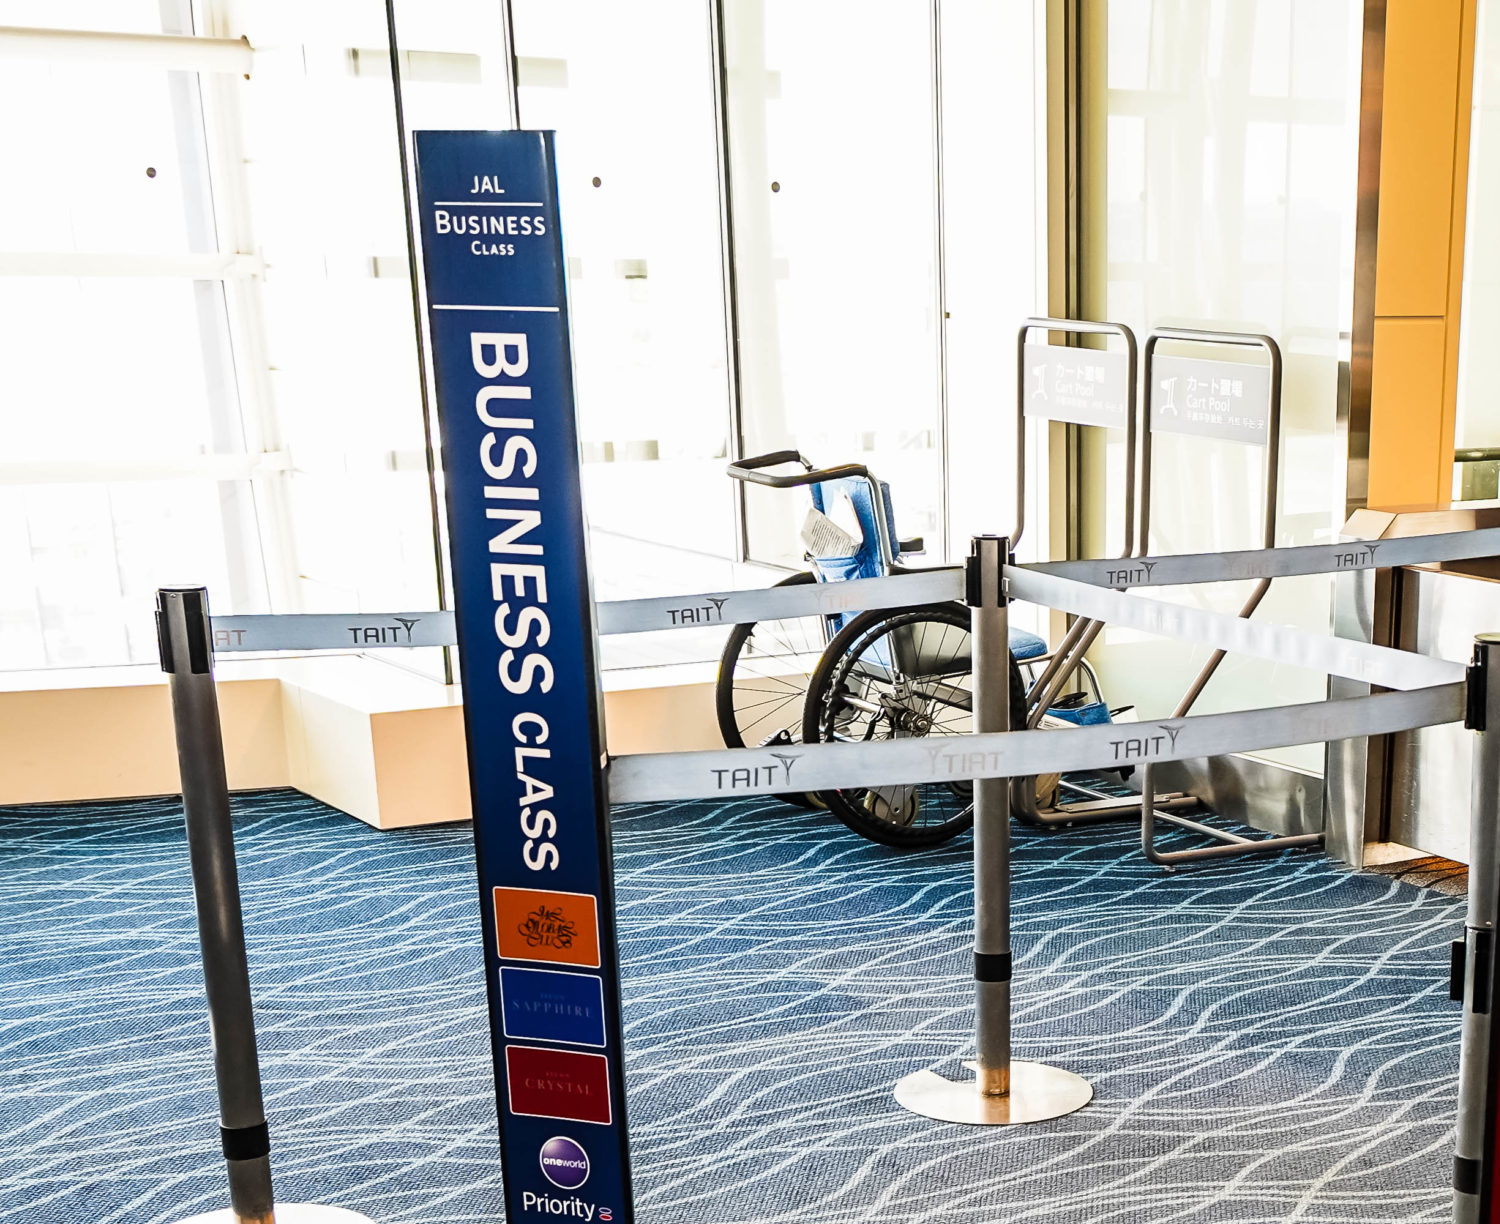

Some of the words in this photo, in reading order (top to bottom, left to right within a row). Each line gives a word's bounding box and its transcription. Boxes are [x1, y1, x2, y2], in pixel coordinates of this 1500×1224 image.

[471, 175, 505, 193] JAL
[434, 210, 546, 235] BUSINESS
[470, 240, 515, 256] CLASS
[1186, 394, 1206, 410] Cart
[1208, 397, 1231, 412] Pool
[470, 331, 555, 695] BUSINESS
[511, 711, 560, 872] CLASS
[543, 1157, 586, 1170] oneworld
[522, 1191, 596, 1222] Priority
